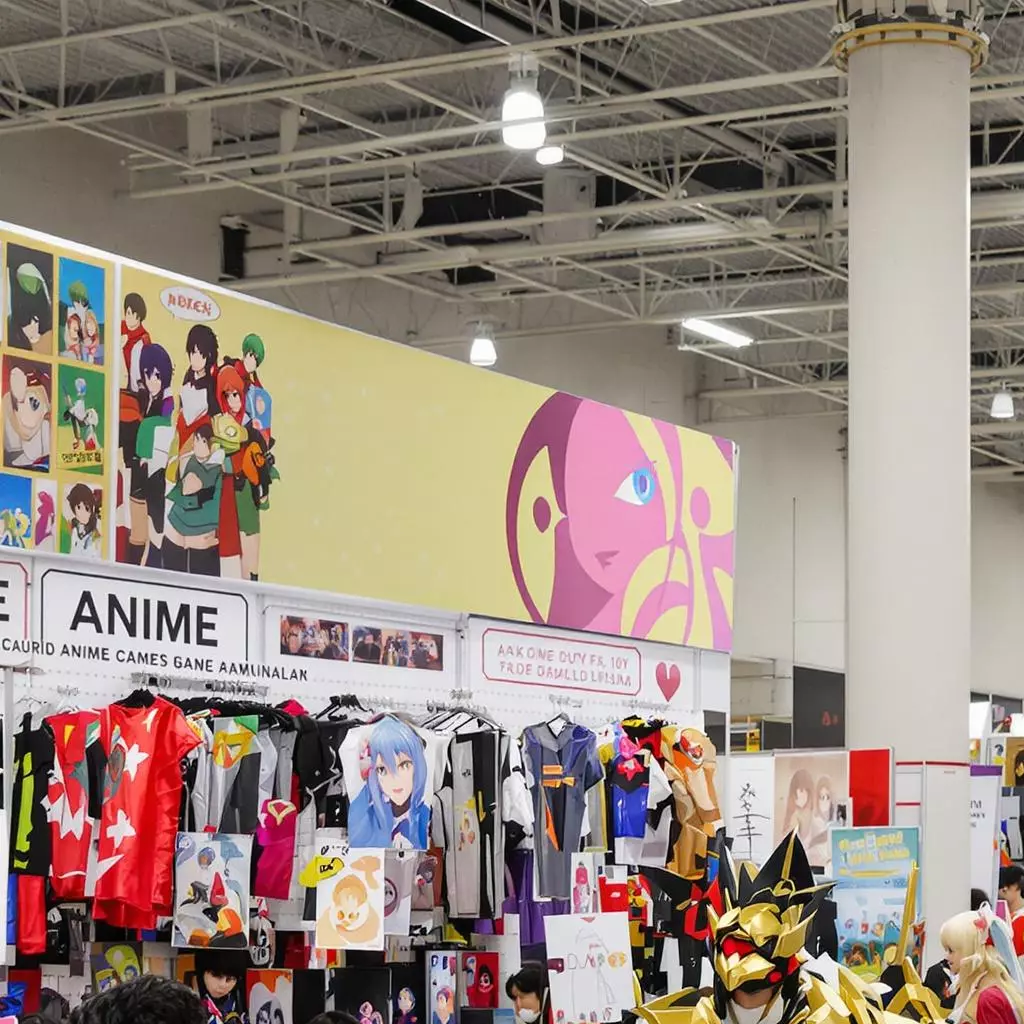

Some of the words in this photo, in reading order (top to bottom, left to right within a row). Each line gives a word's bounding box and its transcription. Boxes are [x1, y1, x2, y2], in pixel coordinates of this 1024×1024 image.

[69, 590, 219, 648] ANIME
[60, 644, 110, 661] ANIME
[116, 650, 168, 667] CAMES
